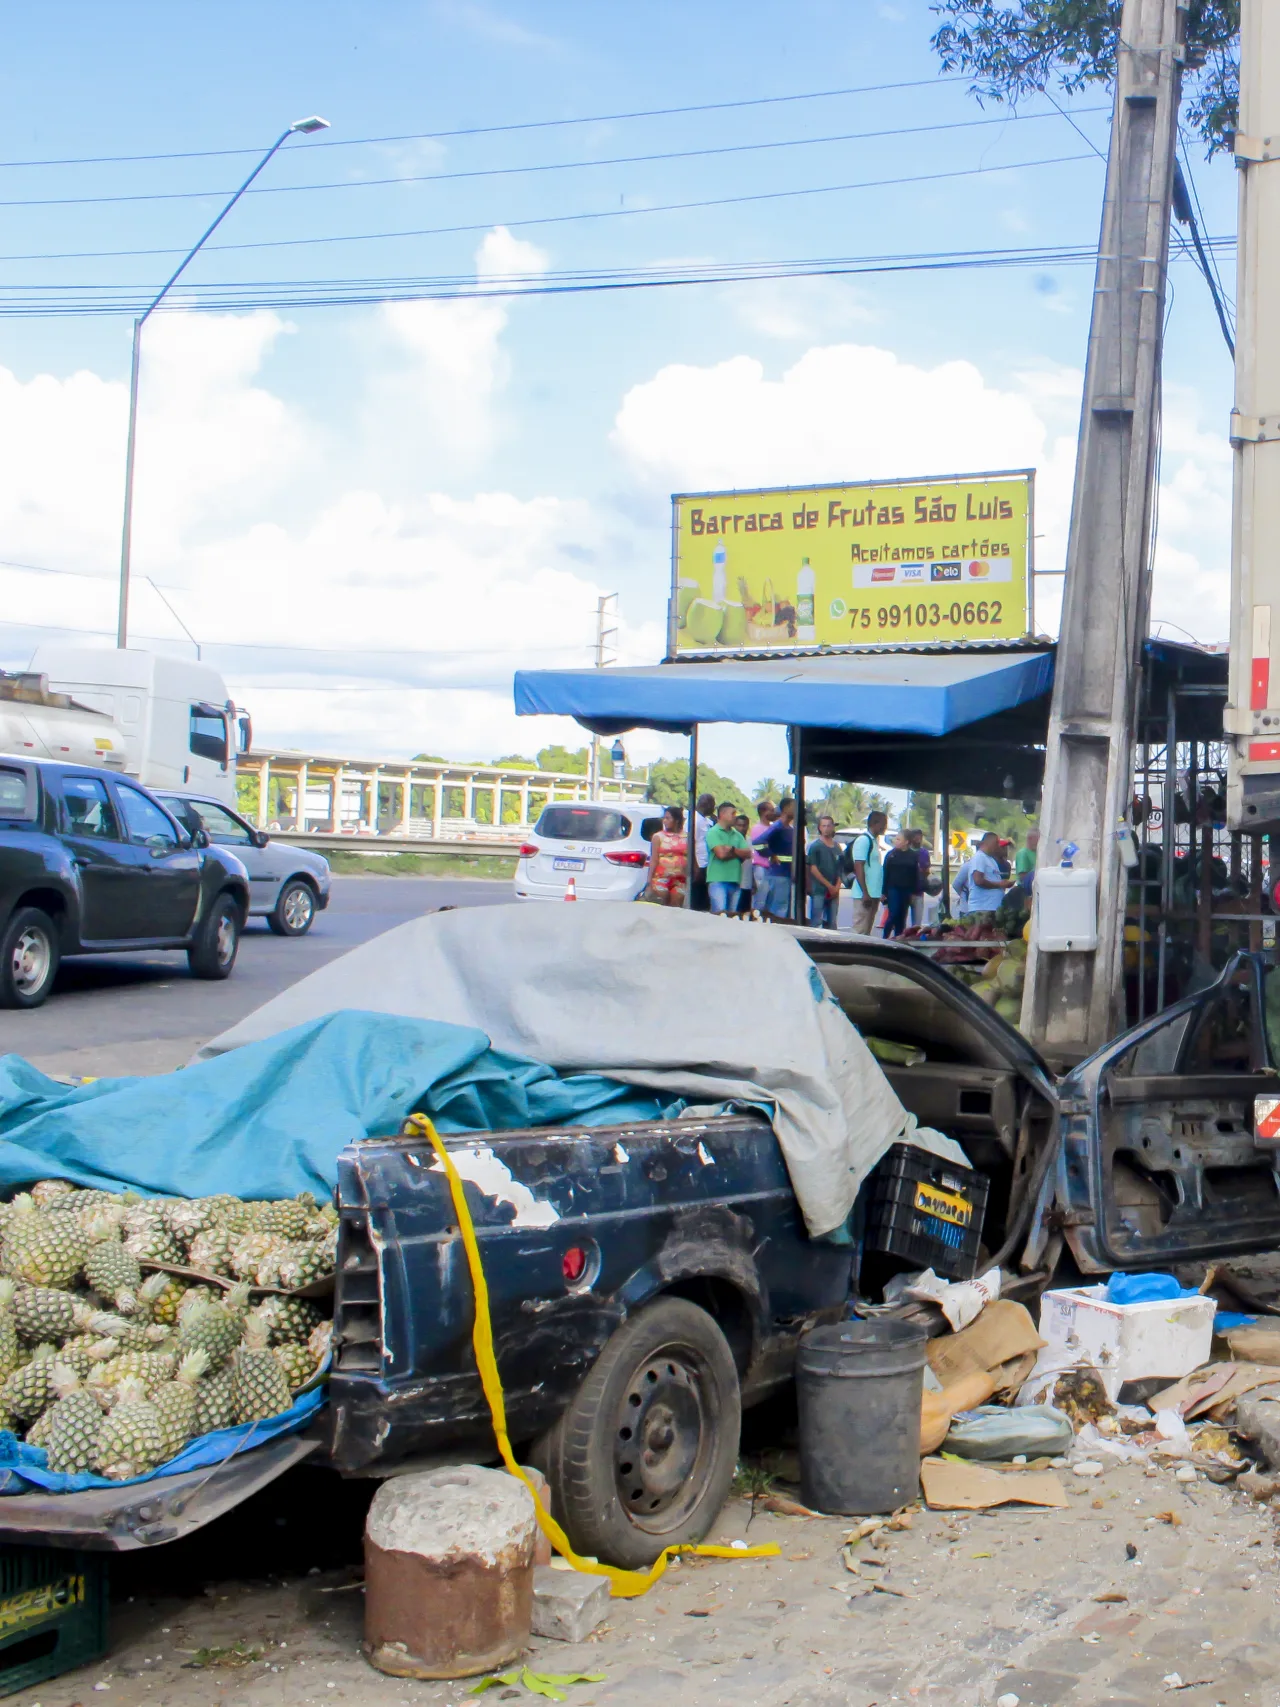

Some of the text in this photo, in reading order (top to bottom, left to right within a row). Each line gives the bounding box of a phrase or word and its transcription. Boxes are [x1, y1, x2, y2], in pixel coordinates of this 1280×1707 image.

[690, 508, 784, 535] Barraca
[792, 503, 819, 529] de
[827, 500, 905, 528] Frutas
[914, 496, 957, 524] São
[851, 538, 1010, 563] Aceitamos cartões
[904, 569, 922, 578] VISA
[848, 601, 1003, 629] 75 99103-0662
